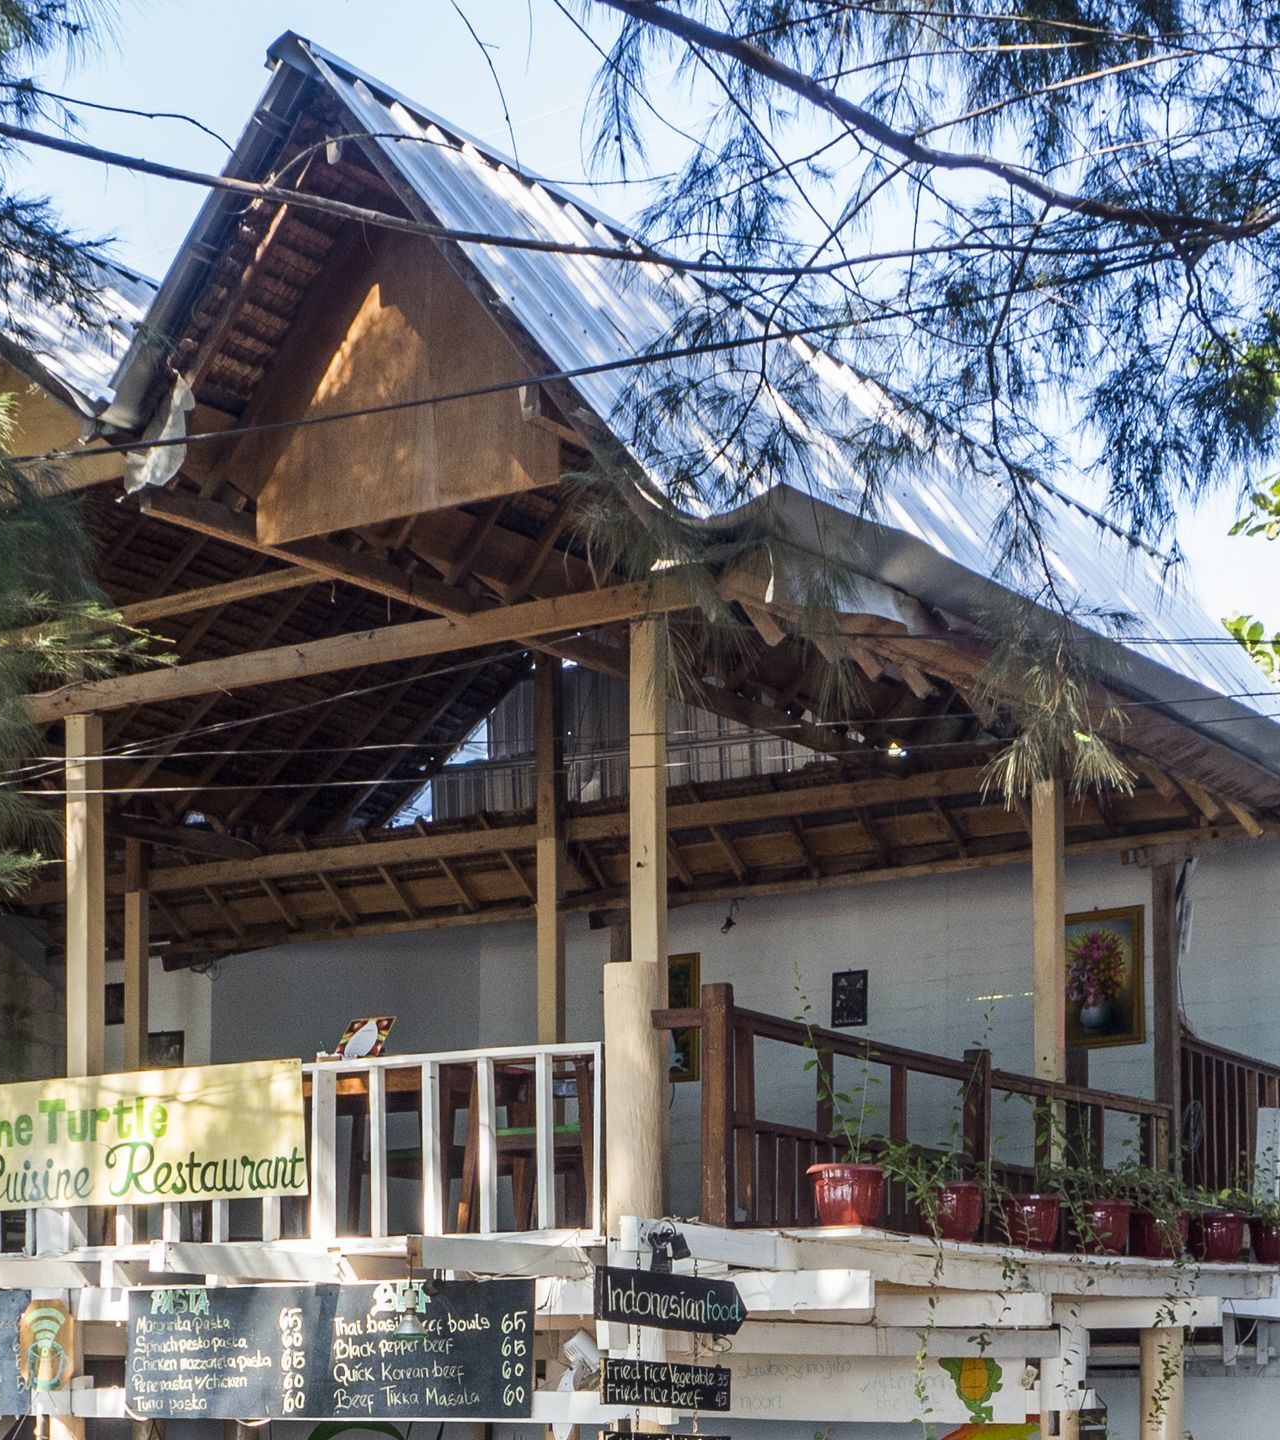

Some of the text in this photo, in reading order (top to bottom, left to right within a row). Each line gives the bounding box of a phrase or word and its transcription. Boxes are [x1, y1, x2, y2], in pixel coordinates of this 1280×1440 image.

[38, 1096, 169, 1145] Turtle
[104, 1141, 306, 1197] Restaurant
[150, 1289, 211, 1316] PASTA
[607, 1274, 743, 1324] Indonesian food
[192, 1314, 230, 1334] pasta
[279, 1307, 303, 1332] 65
[333, 1317, 363, 1337] Thai
[447, 1312, 491, 1333] bowls
[501, 1311, 527, 1334] 65
[281, 1330, 303, 1348] 60
[333, 1338, 376, 1360] Black
[378, 1338, 420, 1358] pepper
[501, 1339, 527, 1357] 65
[236, 1350, 272, 1372] pasta
[281, 1350, 306, 1371] 65
[501, 1361, 524, 1380] 60
[283, 1372, 305, 1390] 60
[333, 1361, 465, 1386] Quick Korean beef
[606, 1360, 641, 1380] Fried
[644, 1364, 667, 1383] rice
[669, 1365, 716, 1388] Vegetable
[716, 1374, 730, 1387] 35
[133, 1393, 207, 1415] Tuna pasta
[282, 1391, 305, 1414] 60
[333, 1385, 481, 1414] Beef Tikka Masala
[503, 1384, 525, 1406] 60
[606, 1384, 703, 1408] Fried rice beef
[715, 1392, 727, 1407] 45
